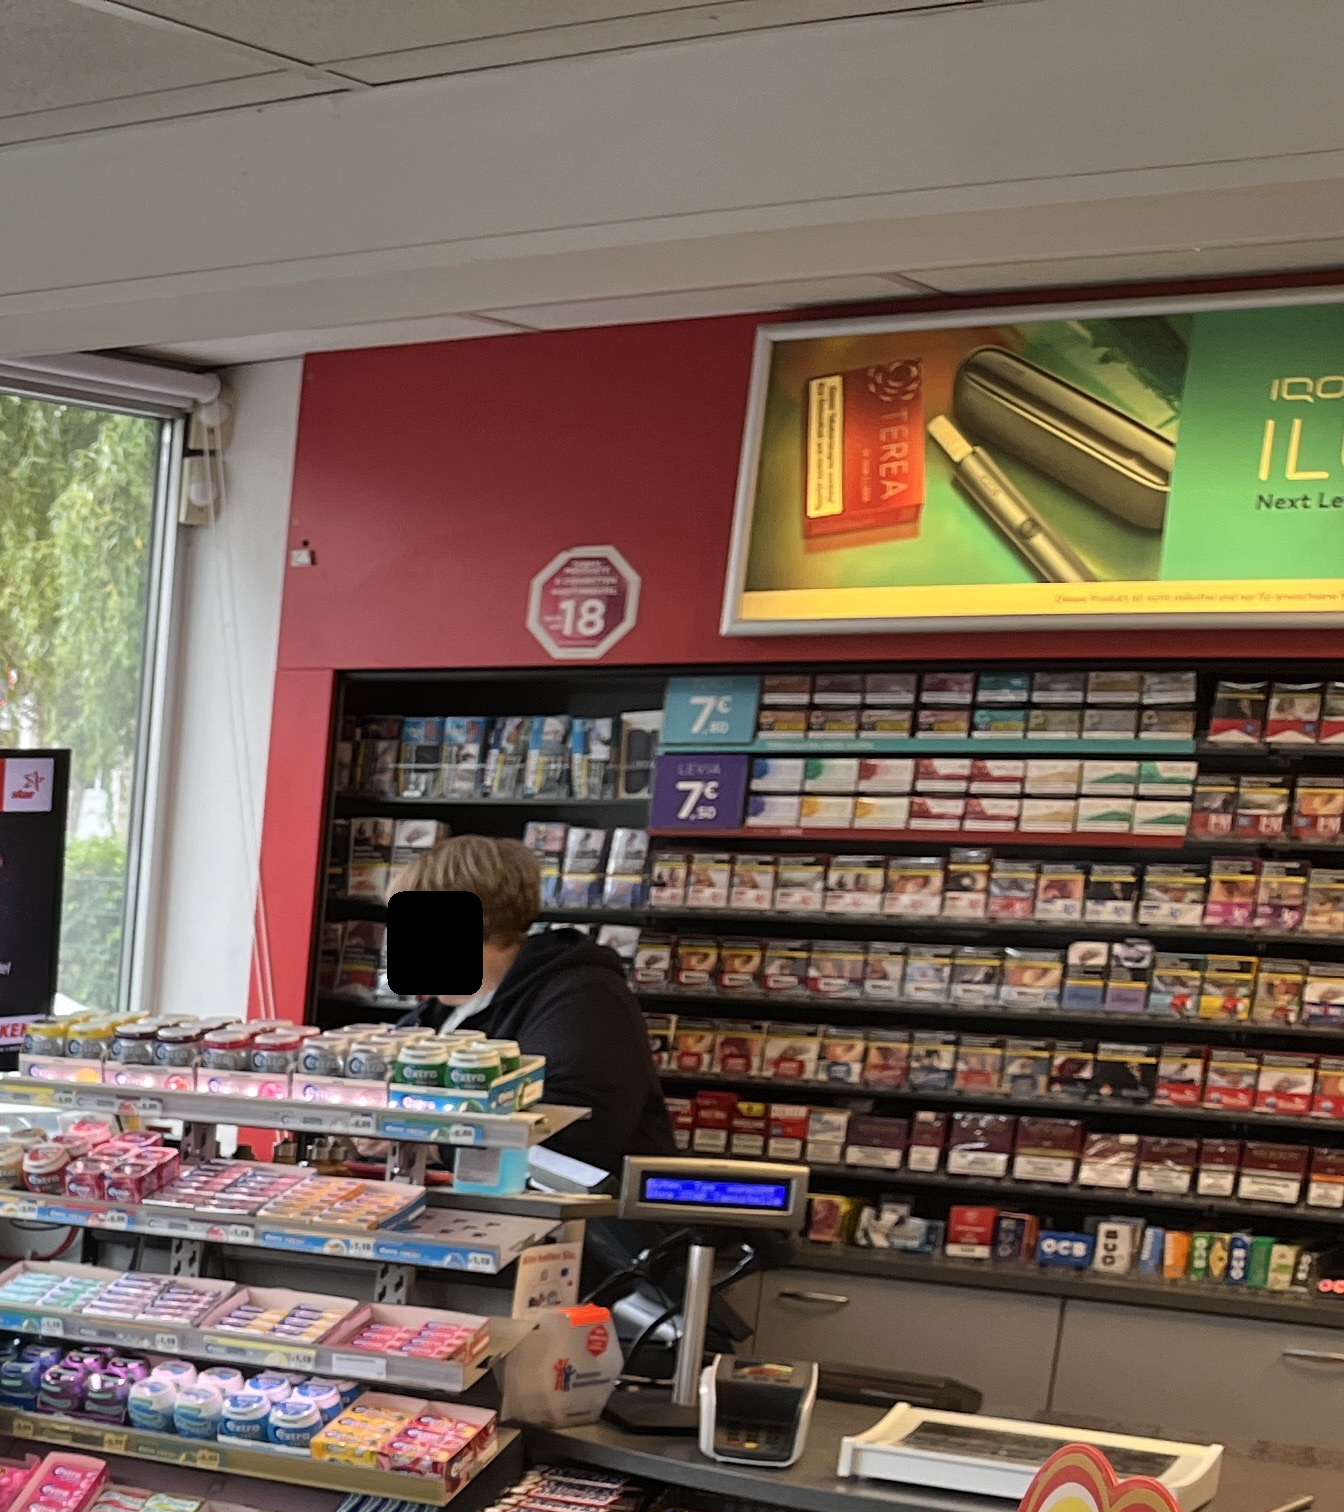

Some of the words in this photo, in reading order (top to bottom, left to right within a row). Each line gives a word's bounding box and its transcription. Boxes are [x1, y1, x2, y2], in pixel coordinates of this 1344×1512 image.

[877, 409, 911, 501] TEREA
[1259, 418, 1344, 483] IL
[1255, 492, 1311, 512] Next
[558, 598, 606, 638] 18
